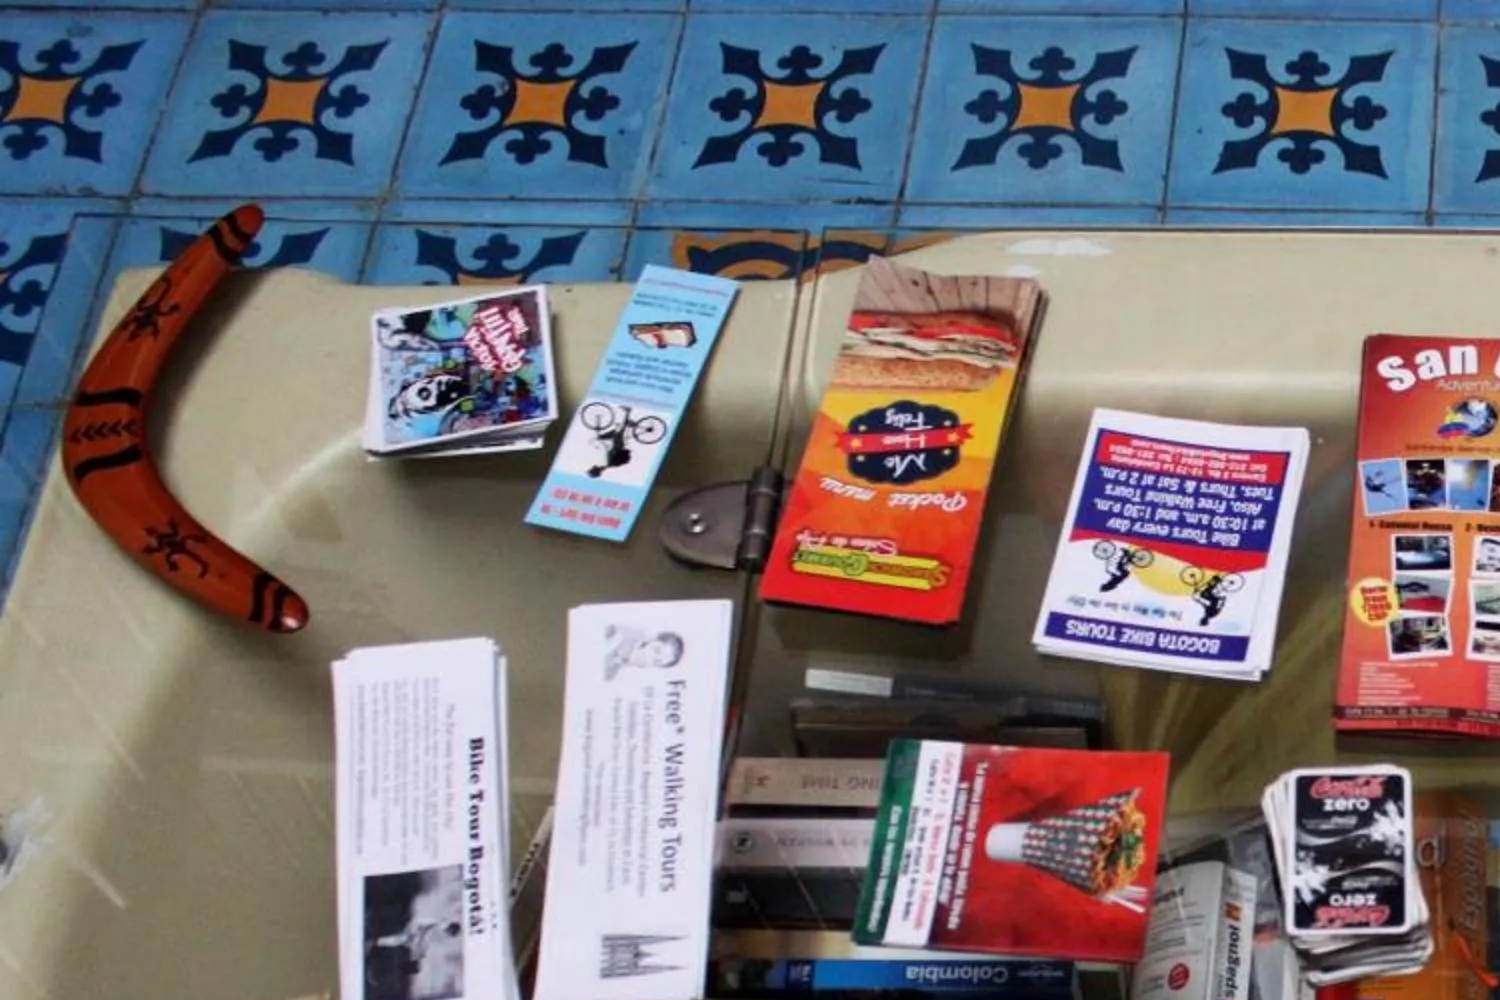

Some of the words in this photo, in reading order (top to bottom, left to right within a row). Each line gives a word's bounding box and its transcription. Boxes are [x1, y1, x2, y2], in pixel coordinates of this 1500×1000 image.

[1376, 344, 1479, 392] San
[1129, 472, 1137, 485] 2
[1141, 473, 1158, 487] at
[1163, 479, 1180, 492] Sat
[1183, 481, 1196, 492] &
[819, 476, 879, 502] menu
[1105, 484, 1143, 502] Tours
[1200, 481, 1236, 498] Thurs
[887, 491, 968, 512] Pocket
[1199, 498, 1226, 513] Free
[1165, 510, 1180, 522] and
[1106, 518, 1130, 532] day
[1132, 523, 1170, 538] every
[1252, 520, 1267, 531] at
[1173, 527, 1208, 544] Tours
[1212, 532, 1240, 547] Bike
[1065, 619, 1116, 640] TOURS
[1120, 627, 1155, 646] BIKE
[1158, 632, 1221, 655] BOGOTA
[468, 736, 485, 785] Bike
[658, 742, 686, 830] Walking
[1322, 797, 1370, 812] zero
[468, 789, 485, 841] Tour
[659, 832, 687, 893] Tours
[466, 844, 486, 936] Bogotá!
[1329, 893, 1377, 906] zero
[905, 963, 1009, 982] Colombia
